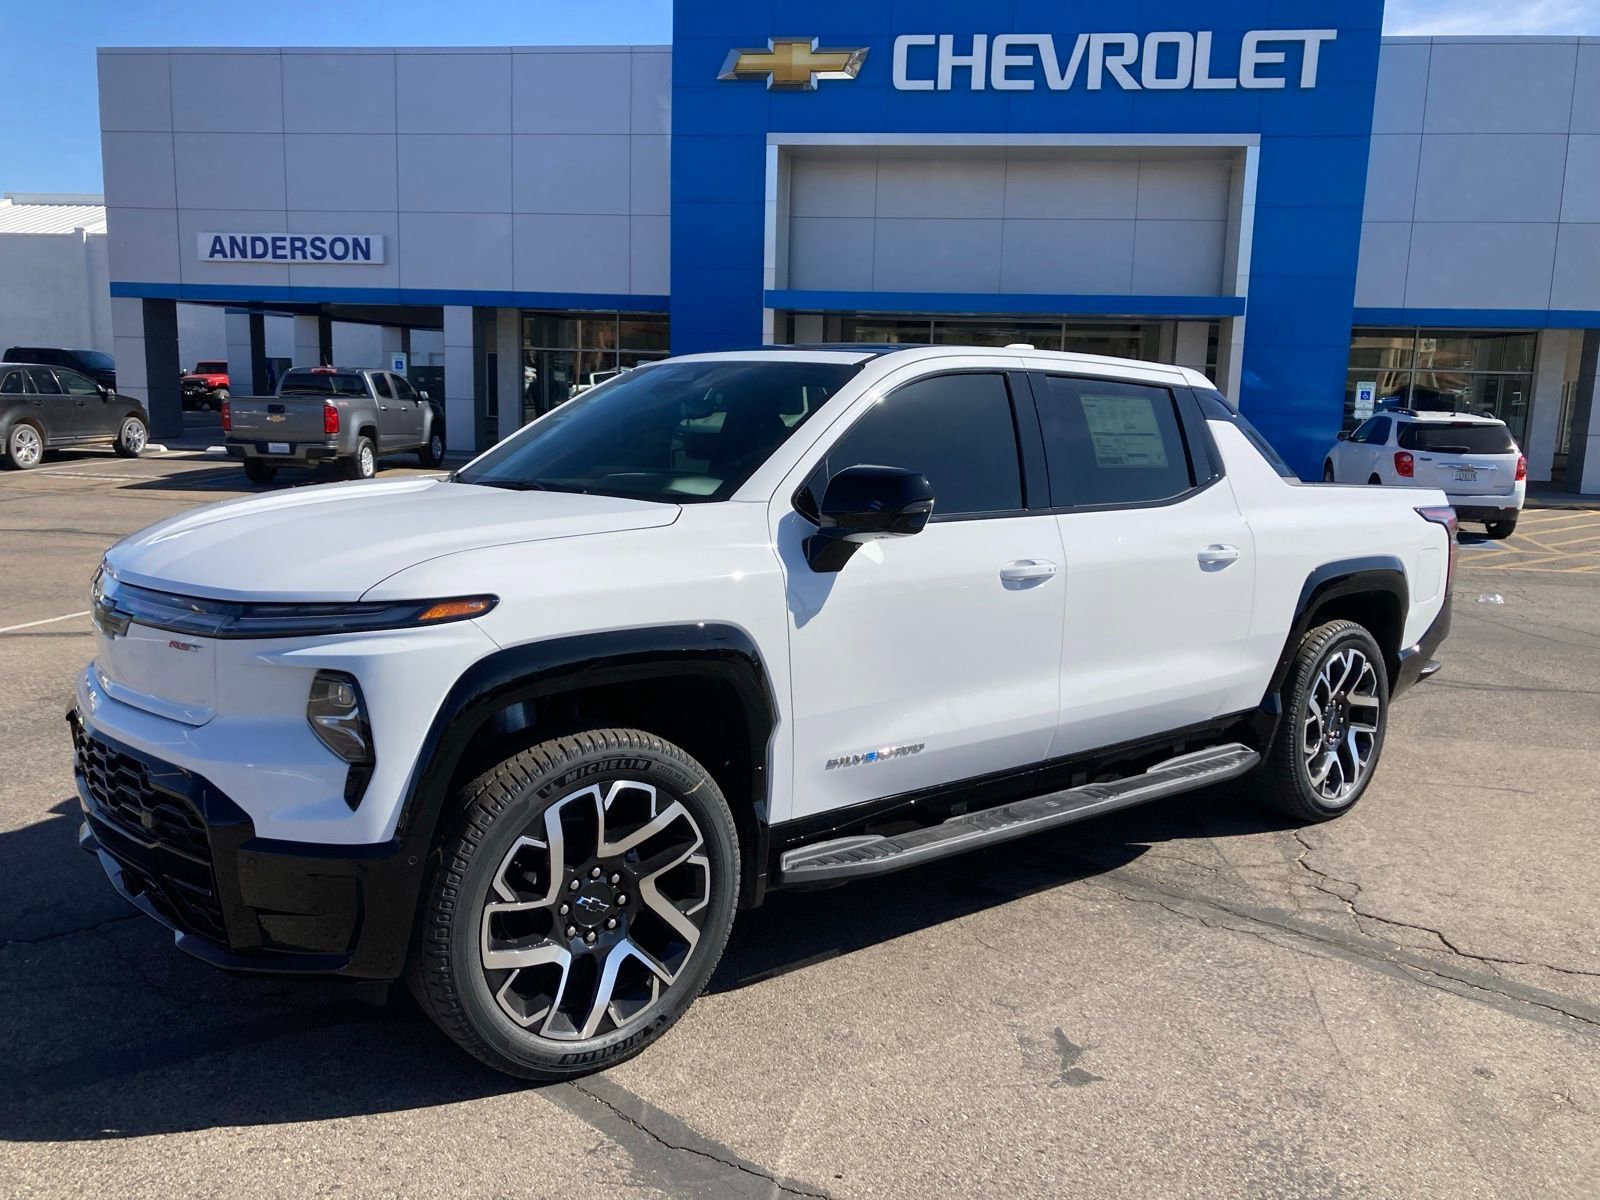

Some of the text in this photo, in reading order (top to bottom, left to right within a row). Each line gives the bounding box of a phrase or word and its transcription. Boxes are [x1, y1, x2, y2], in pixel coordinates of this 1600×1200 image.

[892, 28, 1338, 92] CHEVROLET
[208, 235, 371, 261] ANDERSON
[564, 758, 648, 783] MICHELIN
[563, 1031, 645, 1065] MICHELIN
